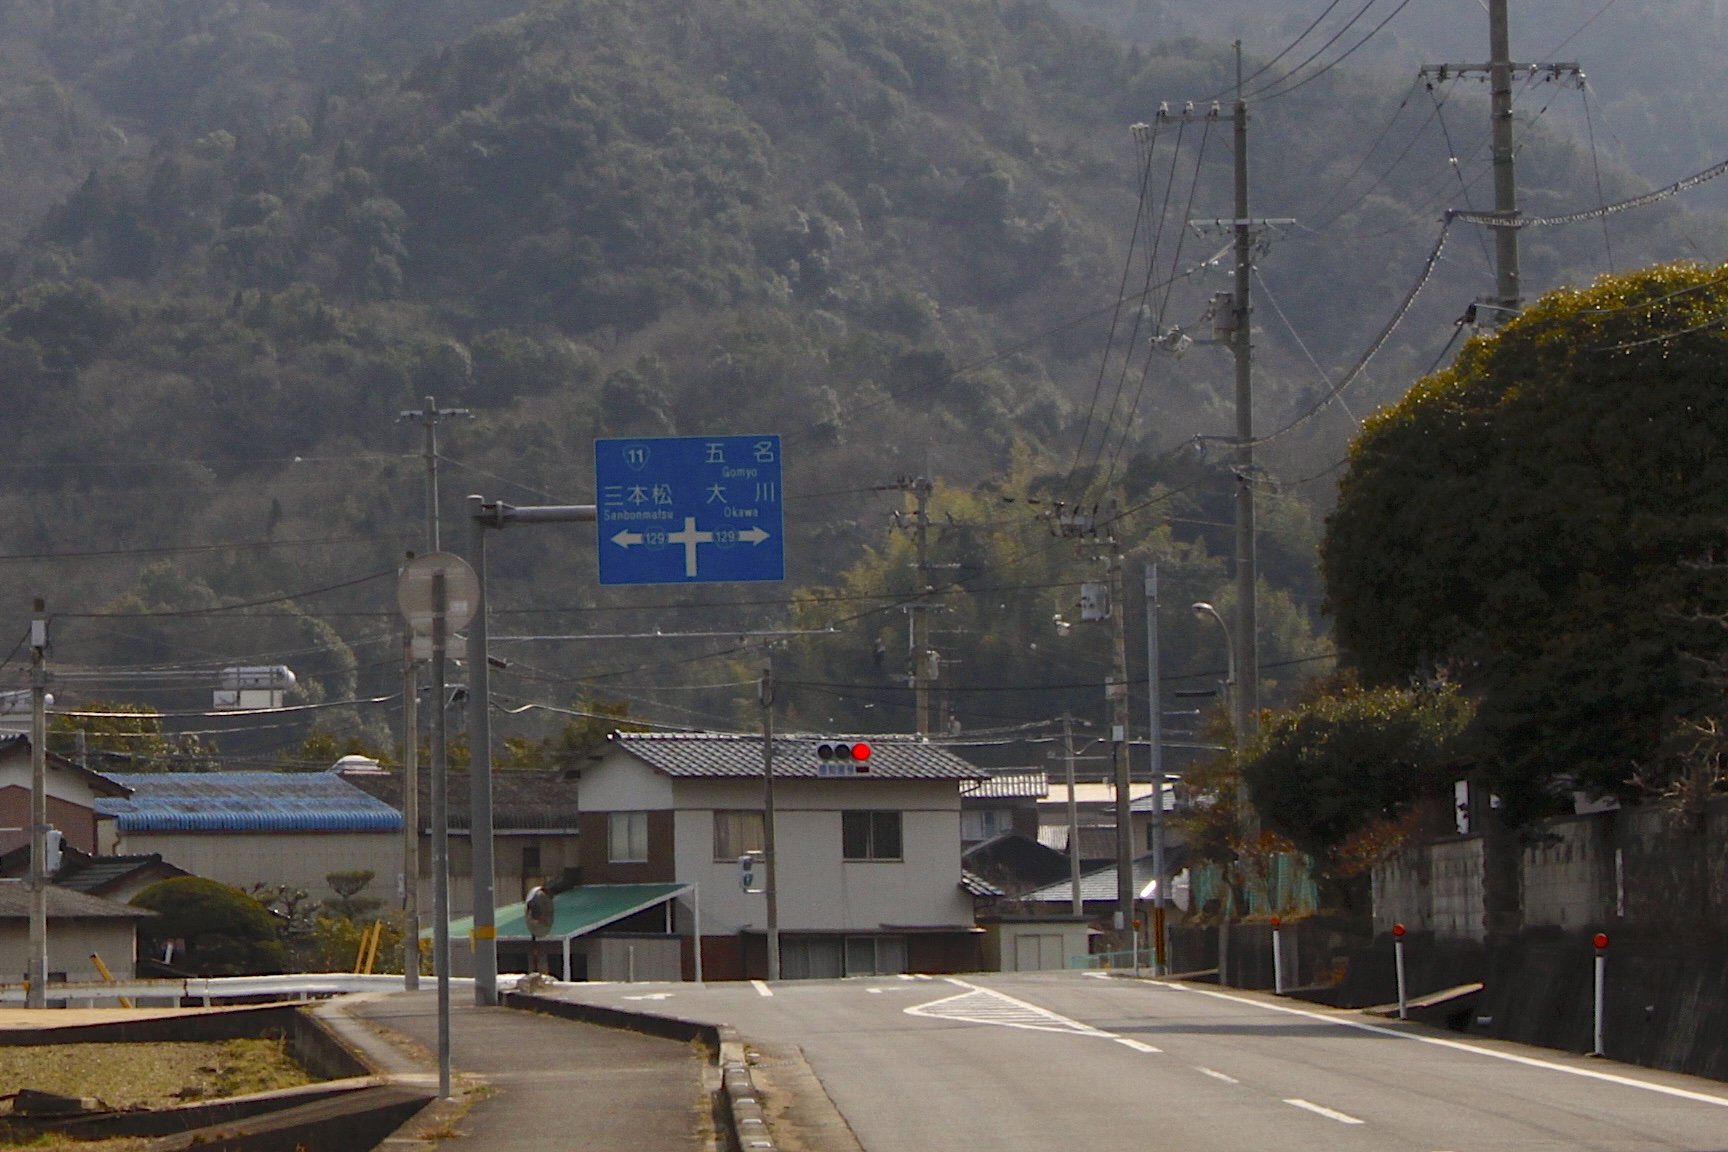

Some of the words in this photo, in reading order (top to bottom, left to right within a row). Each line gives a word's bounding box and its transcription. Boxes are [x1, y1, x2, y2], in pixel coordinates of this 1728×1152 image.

[628, 449, 644, 463] 11
[705, 441, 774, 463] 五名
[723, 466, 758, 479] Gomyo
[604, 484, 673, 506] 三本松
[706, 482, 774, 504] 大川
[604, 509, 673, 521] Sanbonmatsu
[724, 507, 758, 518] Okawa
[645, 532, 665, 545] 129
[716, 530, 735, 543] 129
